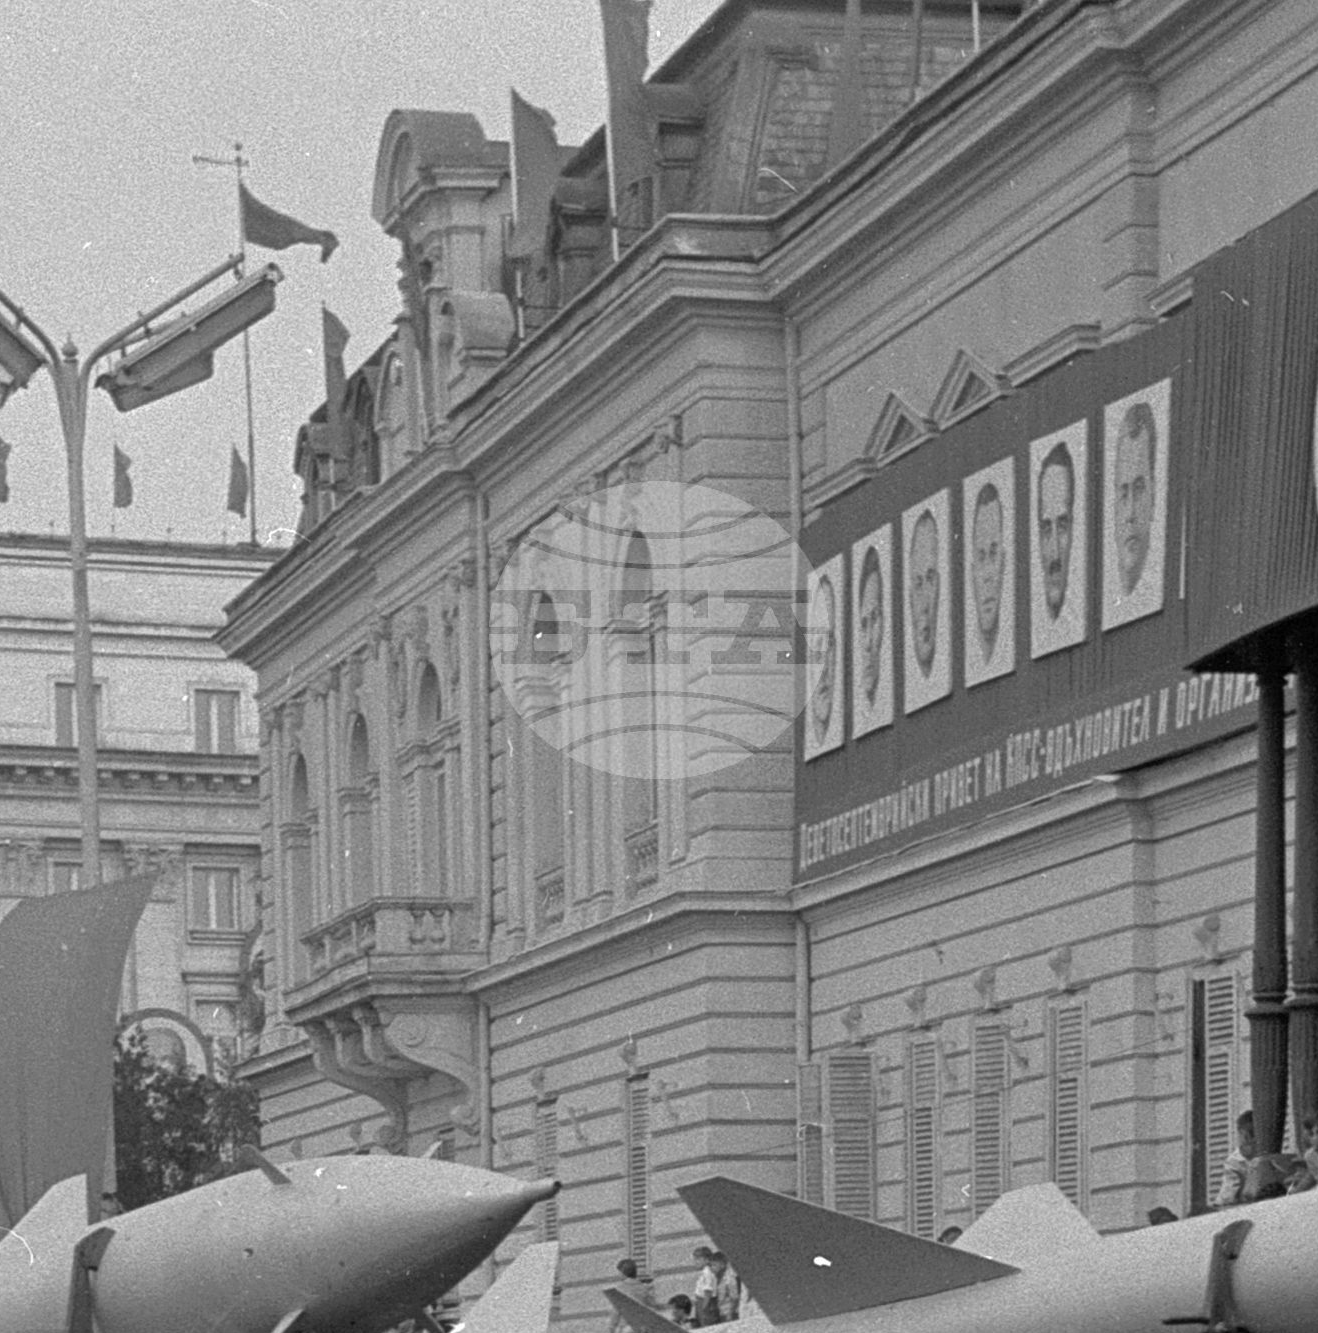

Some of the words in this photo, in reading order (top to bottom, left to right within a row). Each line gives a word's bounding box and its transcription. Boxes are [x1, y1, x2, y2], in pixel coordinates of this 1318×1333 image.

[934, 757, 981, 816] ПРИВЕТ
[984, 748, 1002, 796] НА
[1156, 686, 1169, 735] И
